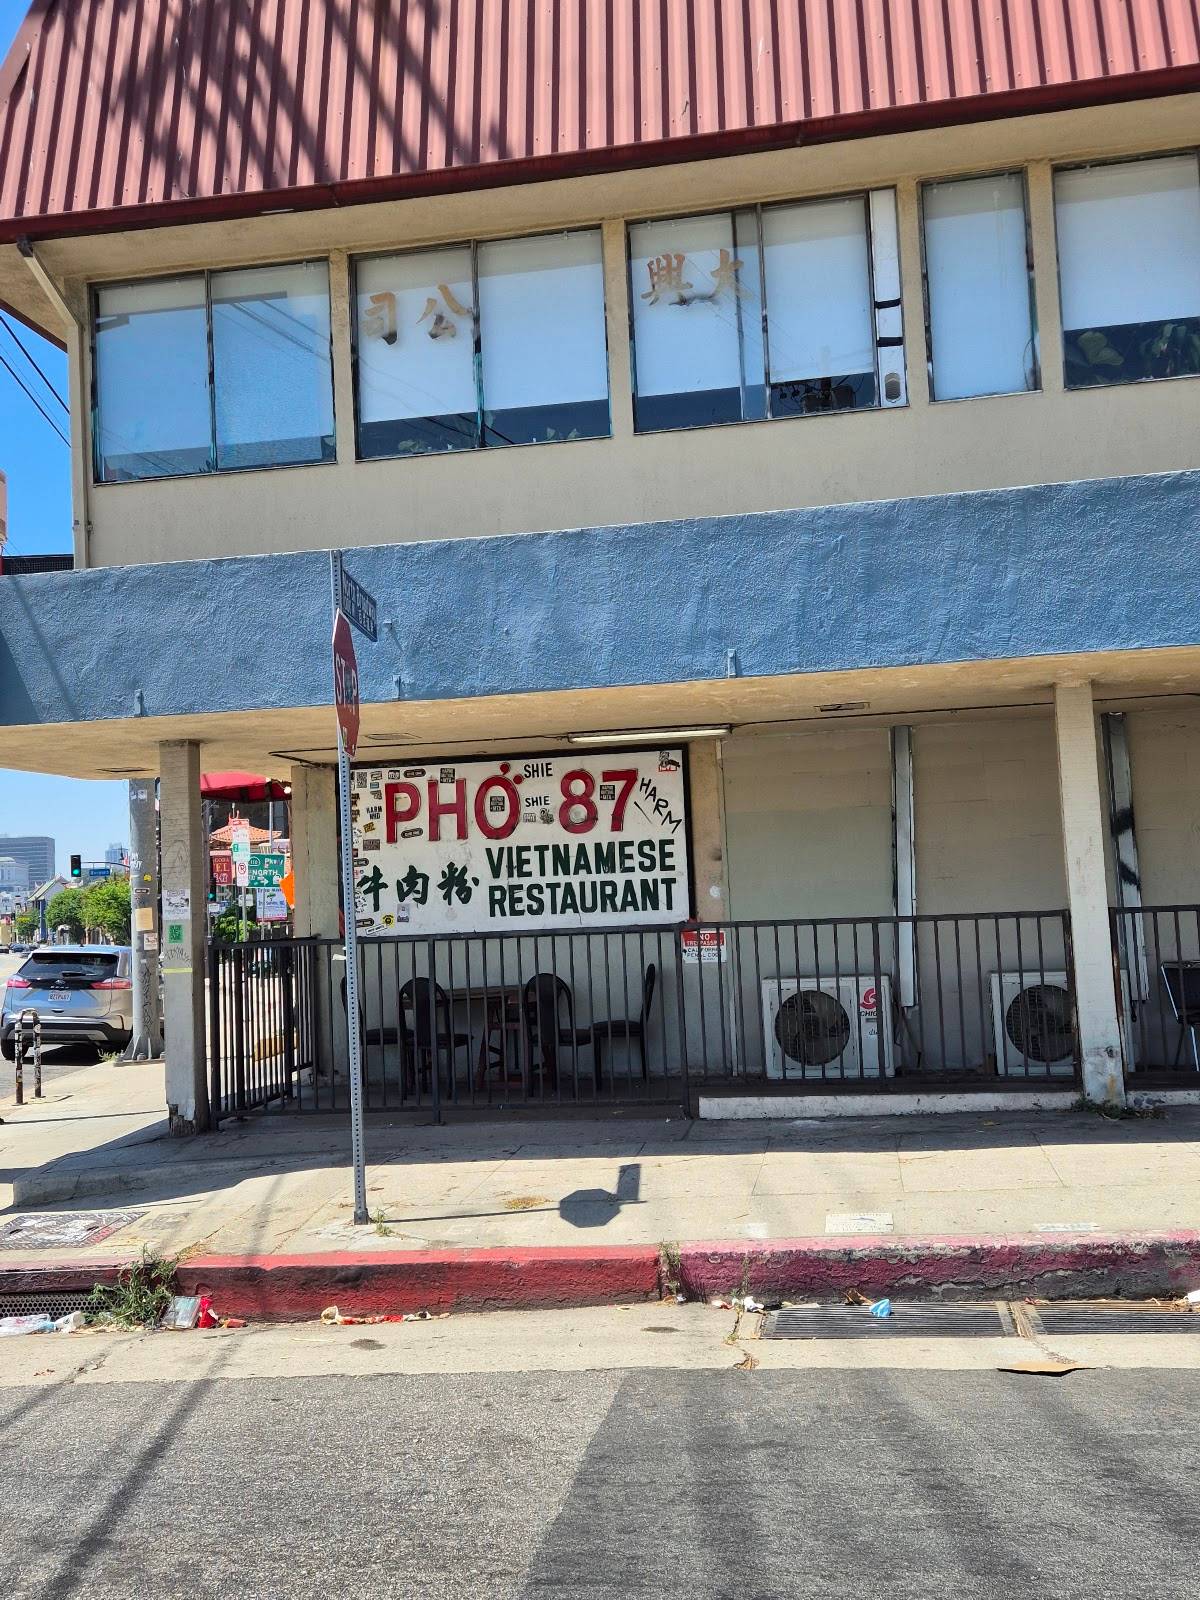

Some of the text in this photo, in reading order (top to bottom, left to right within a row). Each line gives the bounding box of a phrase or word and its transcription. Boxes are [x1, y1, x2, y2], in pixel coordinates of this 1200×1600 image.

[335, 653, 357, 715] STP
[523, 762, 553, 779] SHIE
[525, 795, 551, 808] SHIE
[558, 767, 638, 835] 87
[639, 777, 683, 835] HARM
[485, 838, 677, 880] VIETNAMESE
[356, 861, 480, 913] 牛肉粉
[488, 877, 677, 918] RESTAURANT
[698, 933, 710, 941] NO
